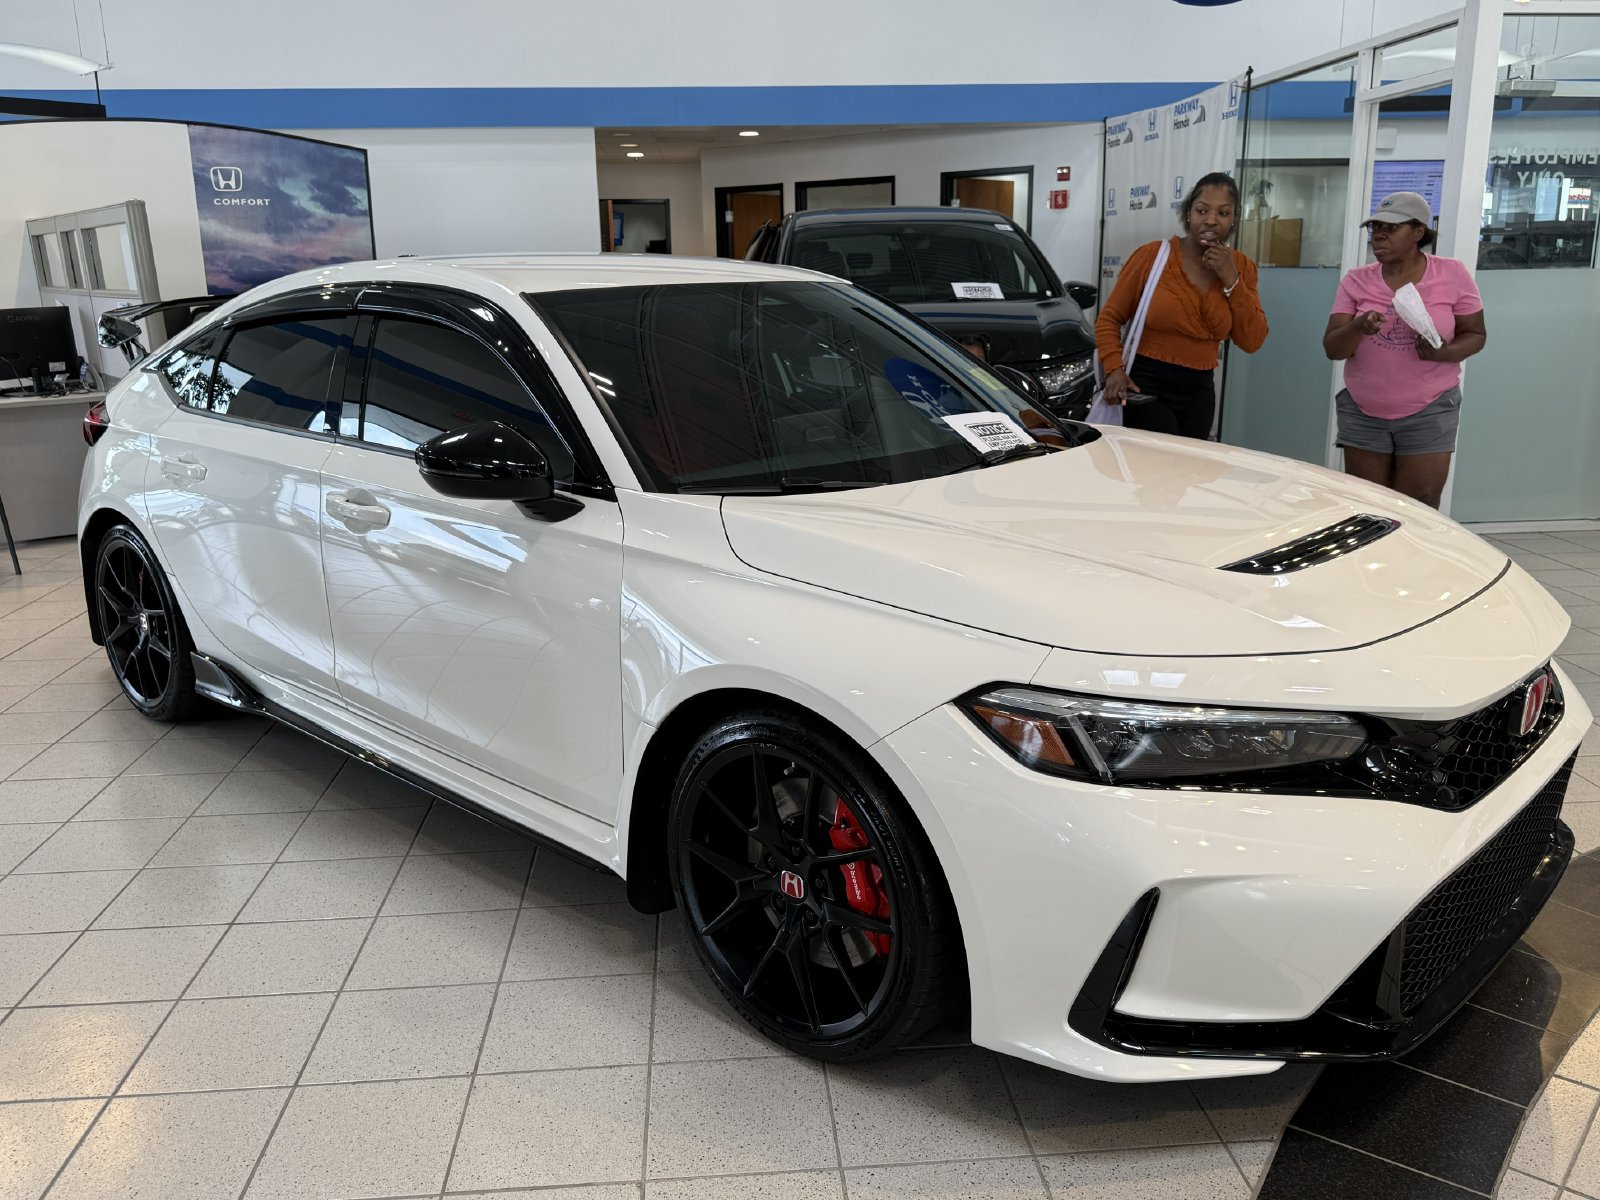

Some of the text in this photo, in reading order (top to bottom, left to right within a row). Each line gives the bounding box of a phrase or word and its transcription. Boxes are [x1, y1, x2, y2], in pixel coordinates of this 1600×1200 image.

[1174, 98, 1199, 116] PARKWAY
[1173, 114, 1189, 130] Honda
[213, 198, 271, 206] COMFORT
[970, 424, 1009, 435] NOTICE
[850, 870, 862, 900] brembo
